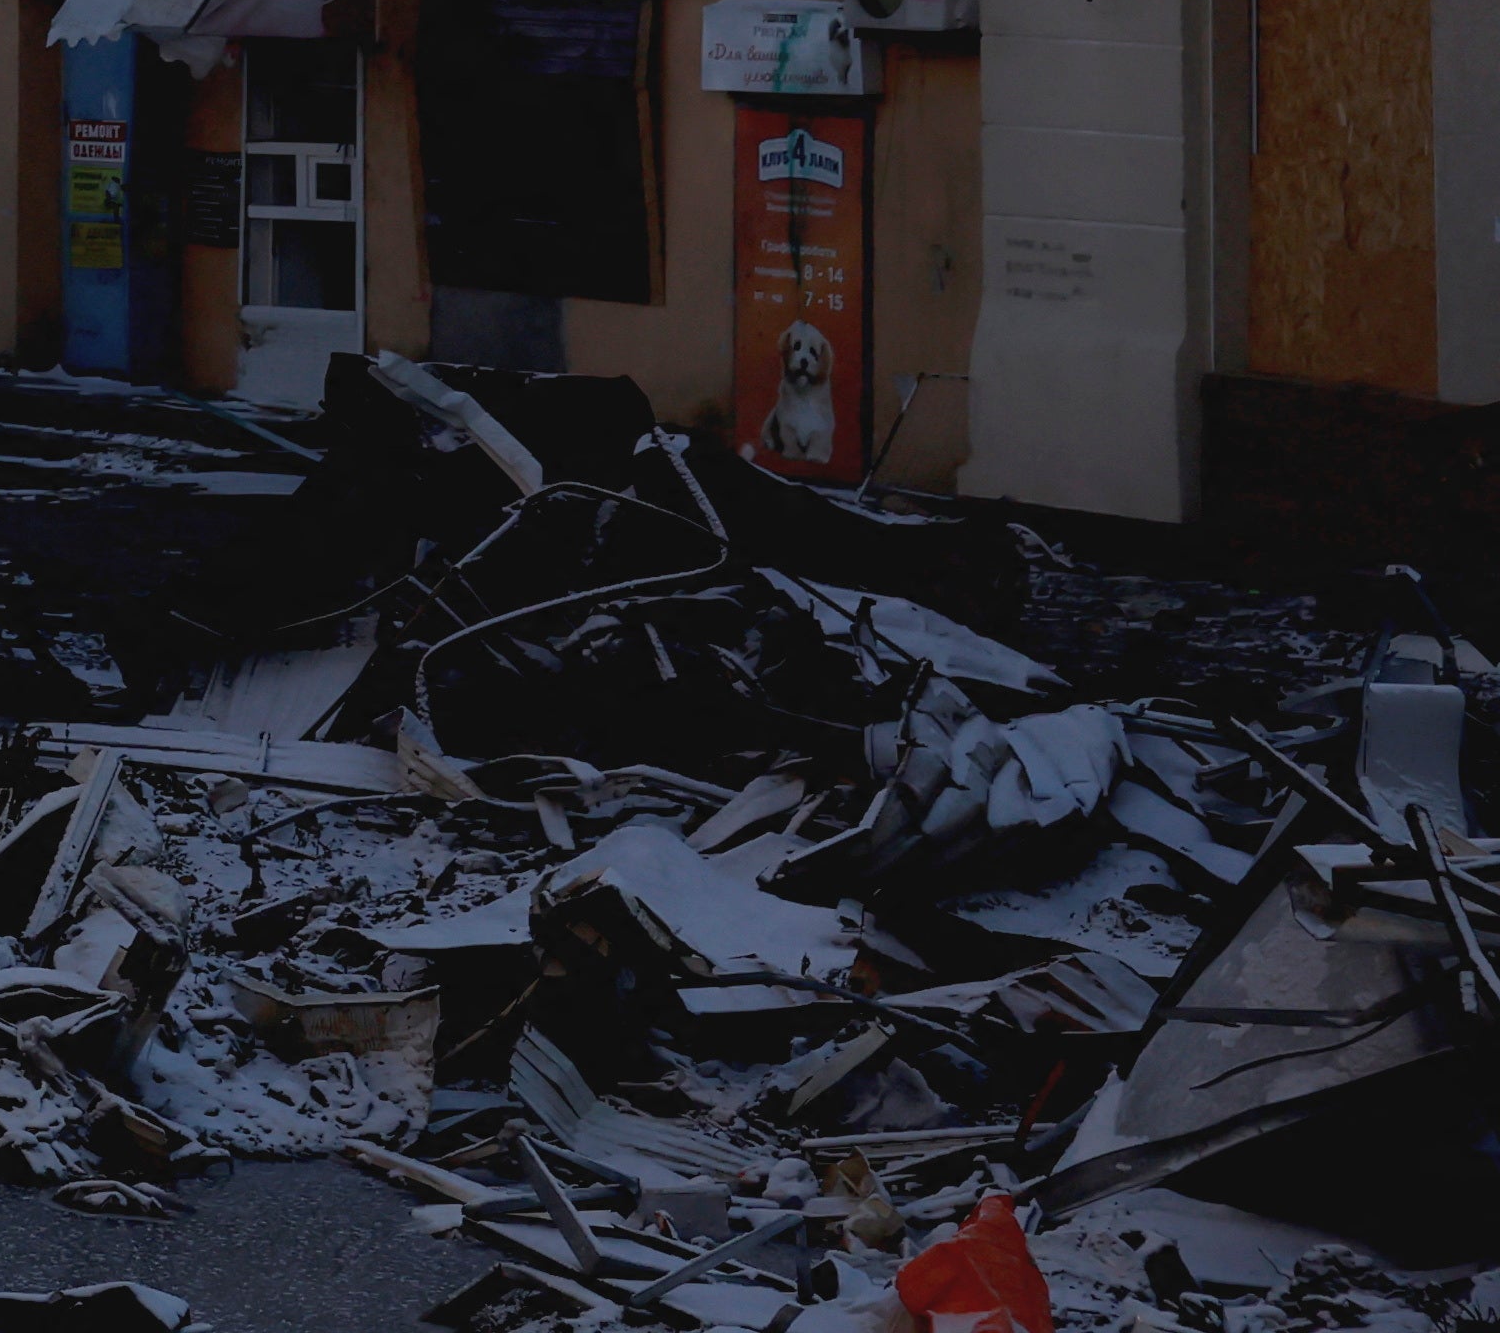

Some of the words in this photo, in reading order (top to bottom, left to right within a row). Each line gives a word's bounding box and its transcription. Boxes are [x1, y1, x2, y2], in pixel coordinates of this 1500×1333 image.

[75, 123, 121, 139] РЕМОНТ
[73, 143, 122, 159] ОДЕЖДЫ
[792, 134, 807, 168] 4
[828, 266, 844, 283] 14
[804, 290, 813, 307] 7
[828, 293, 844, 311] 15
